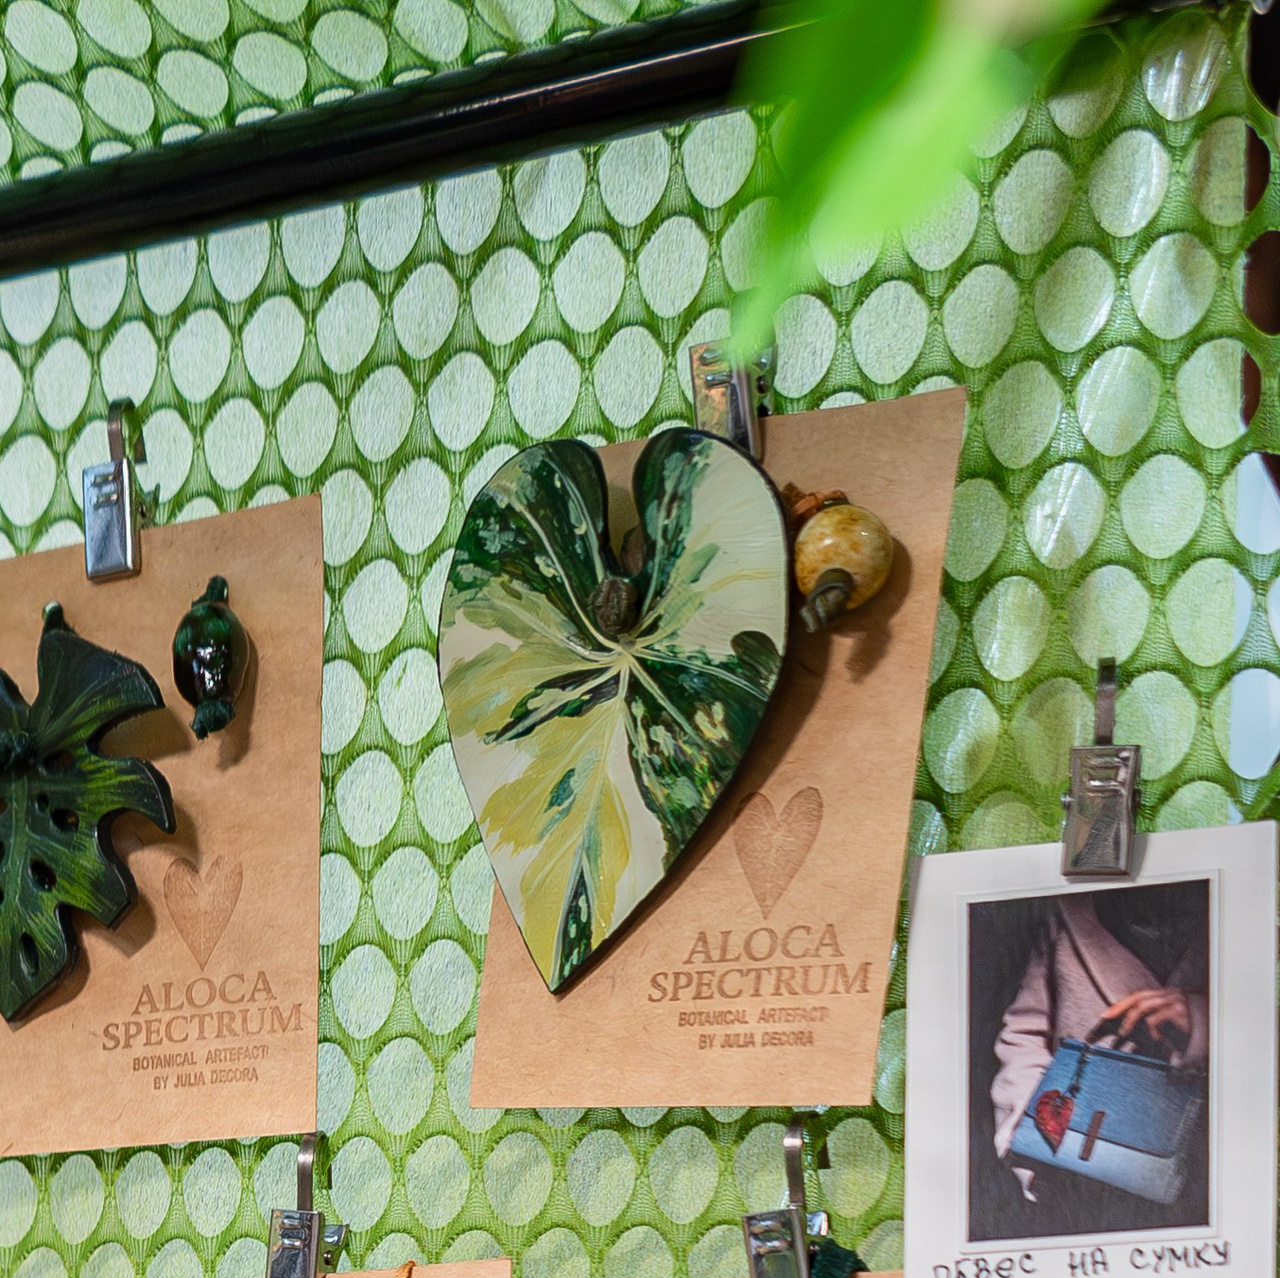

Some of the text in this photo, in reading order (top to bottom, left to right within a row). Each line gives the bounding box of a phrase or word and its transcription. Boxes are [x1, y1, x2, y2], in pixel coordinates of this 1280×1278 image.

[683, 924, 845, 964] ALOCA
[131, 971, 277, 1016] ALOCA
[648, 962, 872, 1002] SPECTRUM
[102, 1003, 304, 1051] SPECTRUM
[133, 1053, 197, 1071] BOTANICAL
[154, 1067, 258, 1090] BY JULIA DECORA
[1129, 1241, 1232, 1273] СУМКУ
